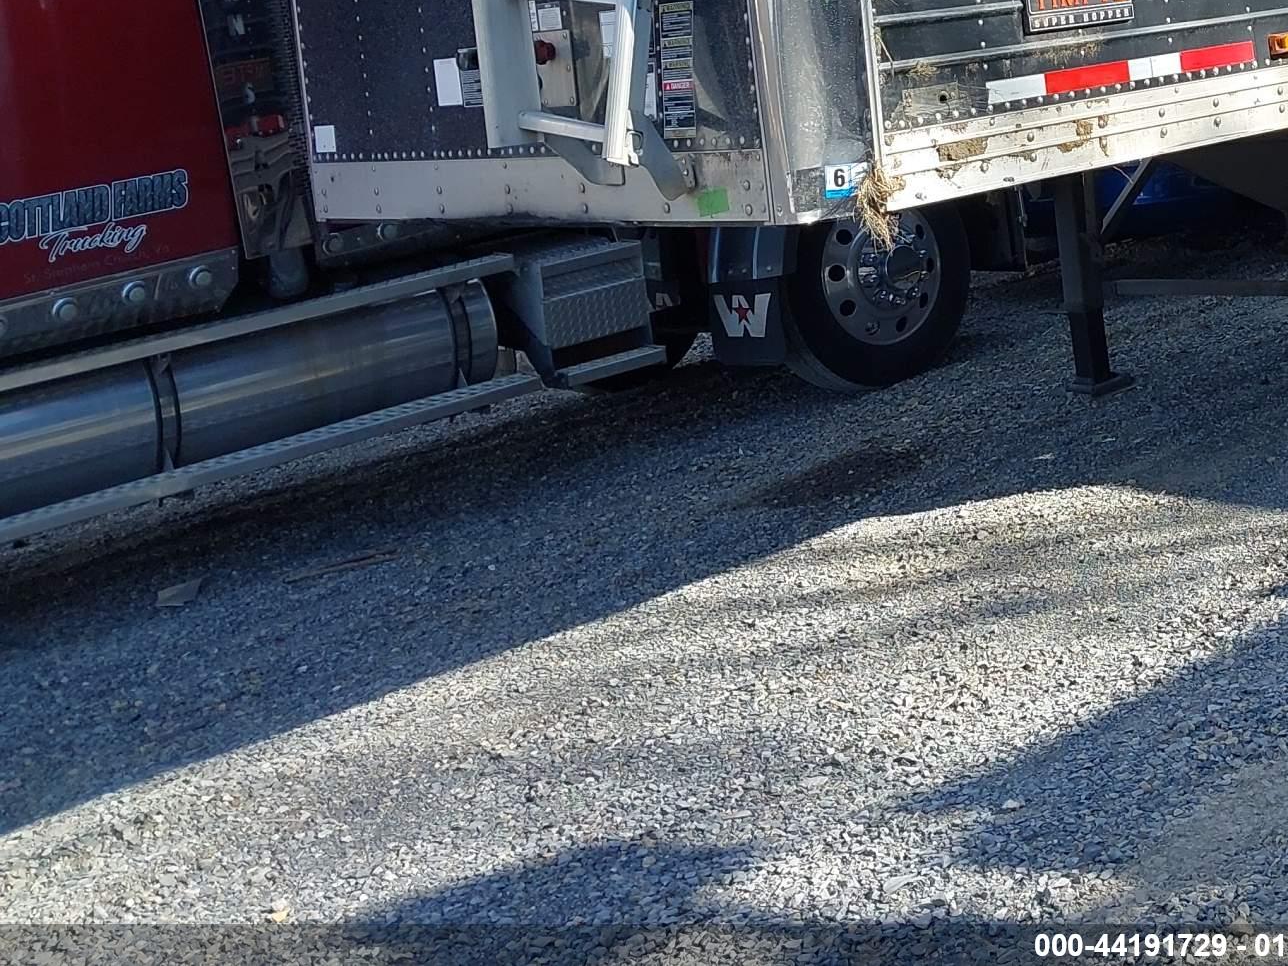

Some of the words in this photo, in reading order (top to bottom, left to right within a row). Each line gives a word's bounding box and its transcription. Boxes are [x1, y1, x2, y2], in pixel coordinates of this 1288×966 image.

[1034, 14, 1075, 28] SUPER
[1083, 8, 1130, 22] HOPPER
[833, 168, 846, 188] 6
[111, 169, 188, 222] FARMS
[39, 222, 147, 263] Trucking
